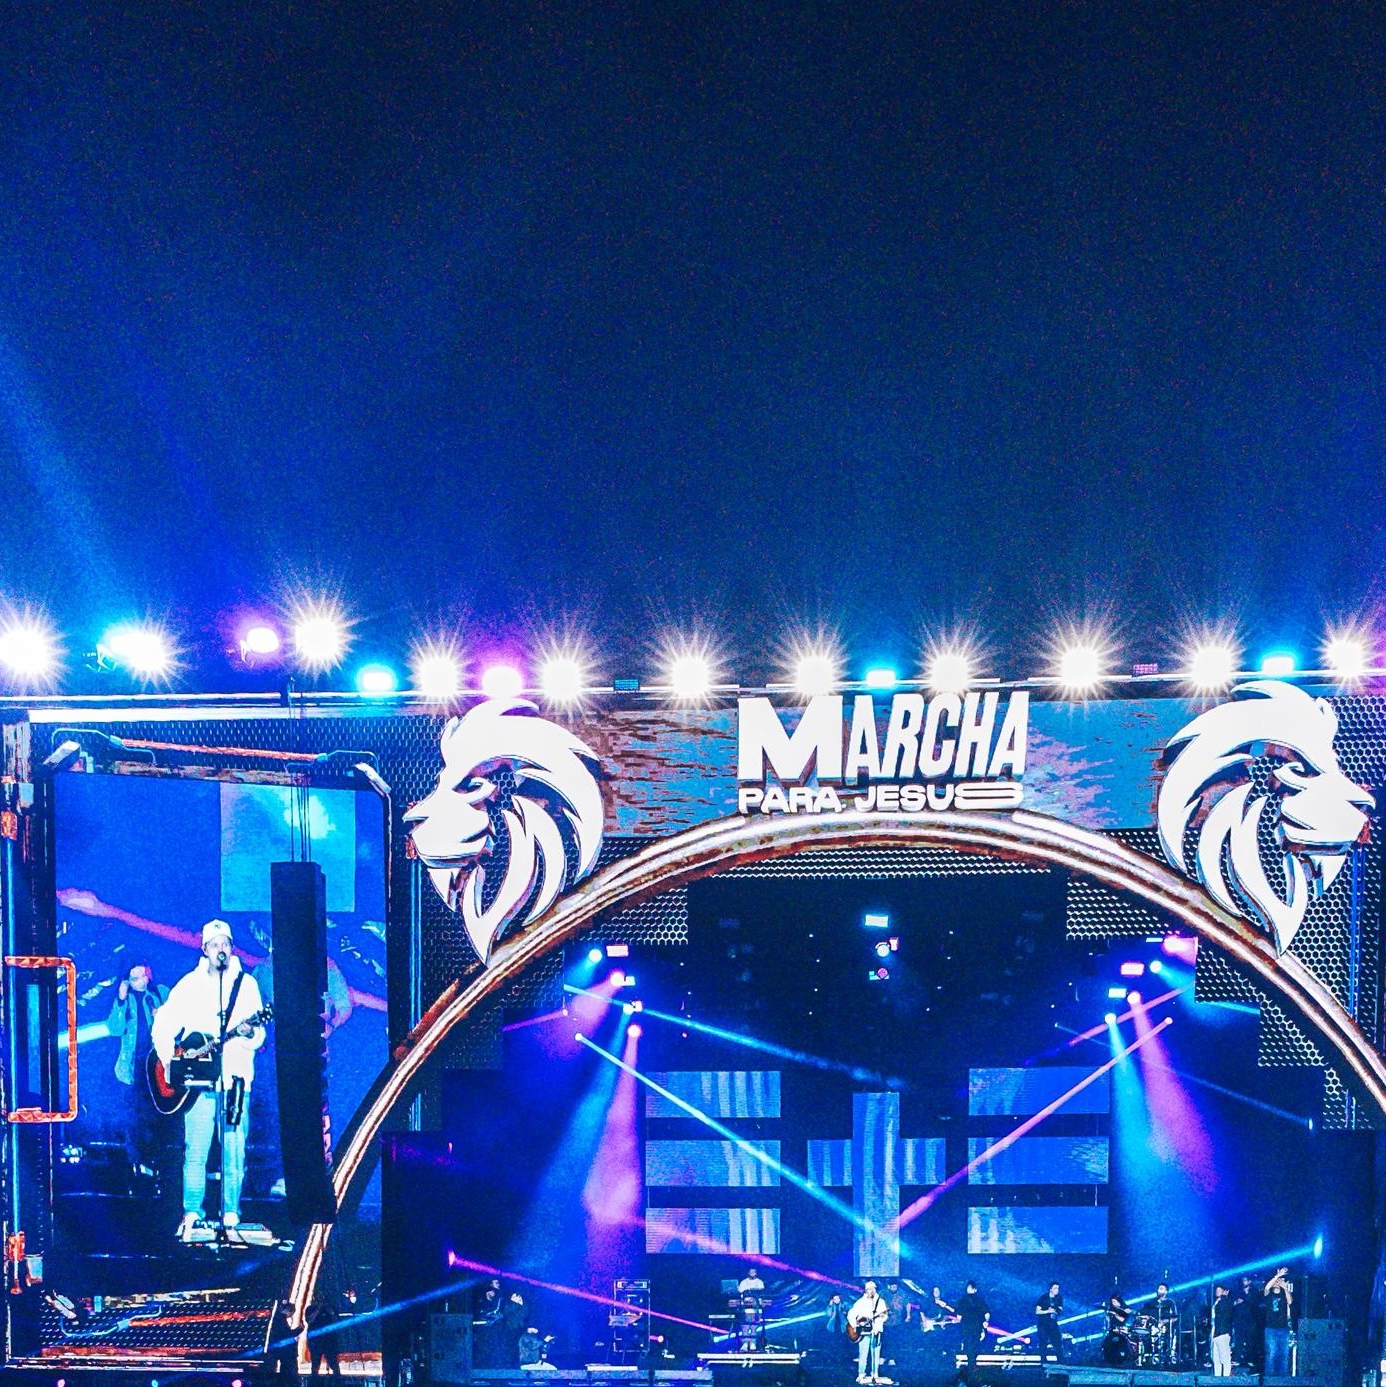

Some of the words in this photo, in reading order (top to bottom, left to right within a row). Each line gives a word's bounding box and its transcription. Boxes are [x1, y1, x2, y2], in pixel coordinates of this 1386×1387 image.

[738, 691, 1029, 780] MARCHA
[738, 786, 844, 814] PARA
[854, 782, 1024, 813] JESUS
